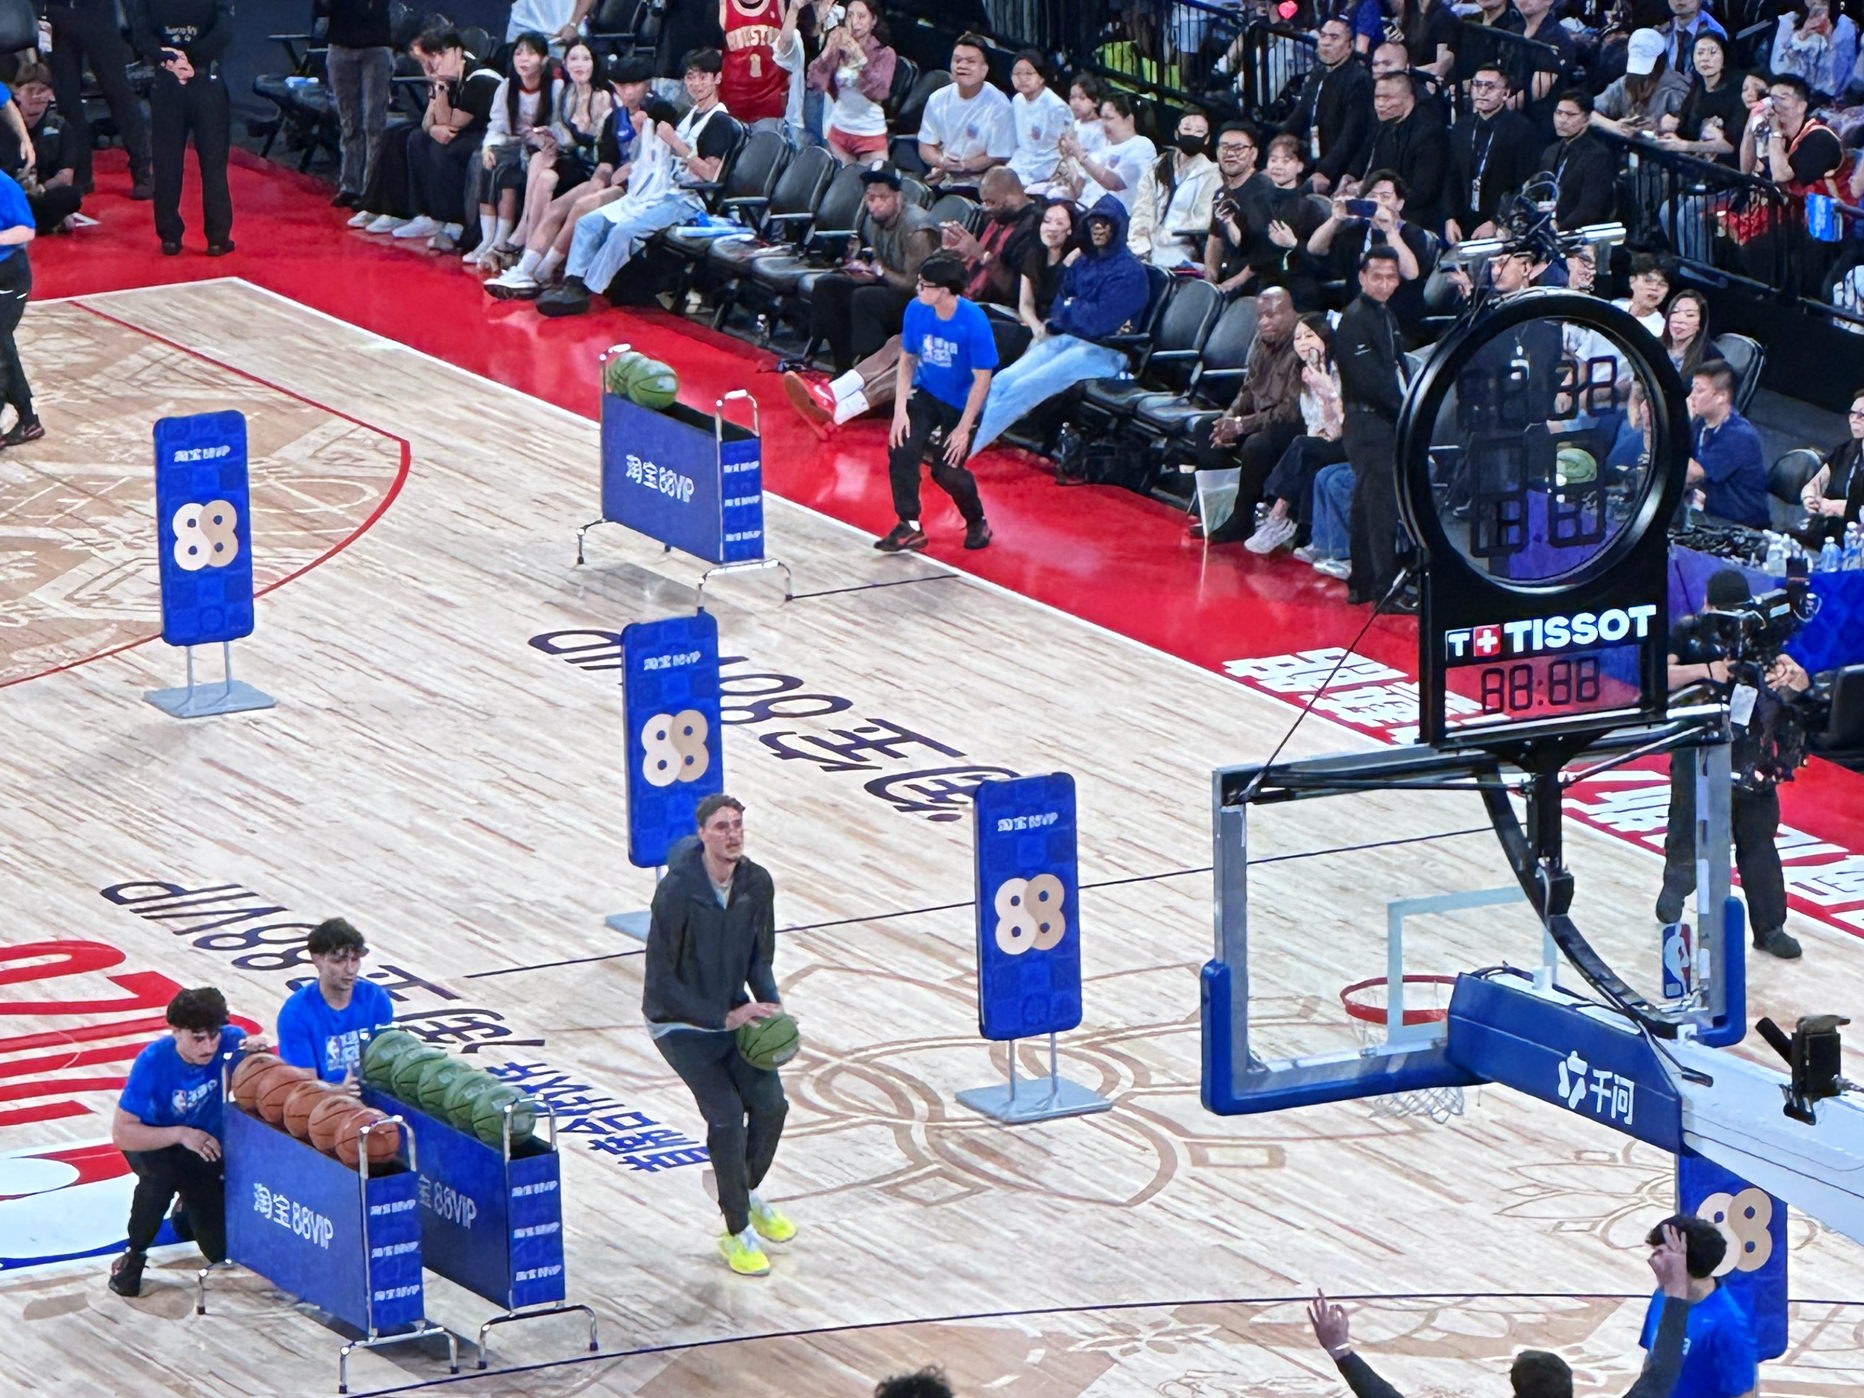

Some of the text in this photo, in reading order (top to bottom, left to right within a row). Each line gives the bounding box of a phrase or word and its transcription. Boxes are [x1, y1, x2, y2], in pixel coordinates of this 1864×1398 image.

[1503, 604, 1657, 654] TISSOT
[1589, 1068, 1635, 1126] 千问
[253, 1182, 334, 1250] 淘宝88VIP
